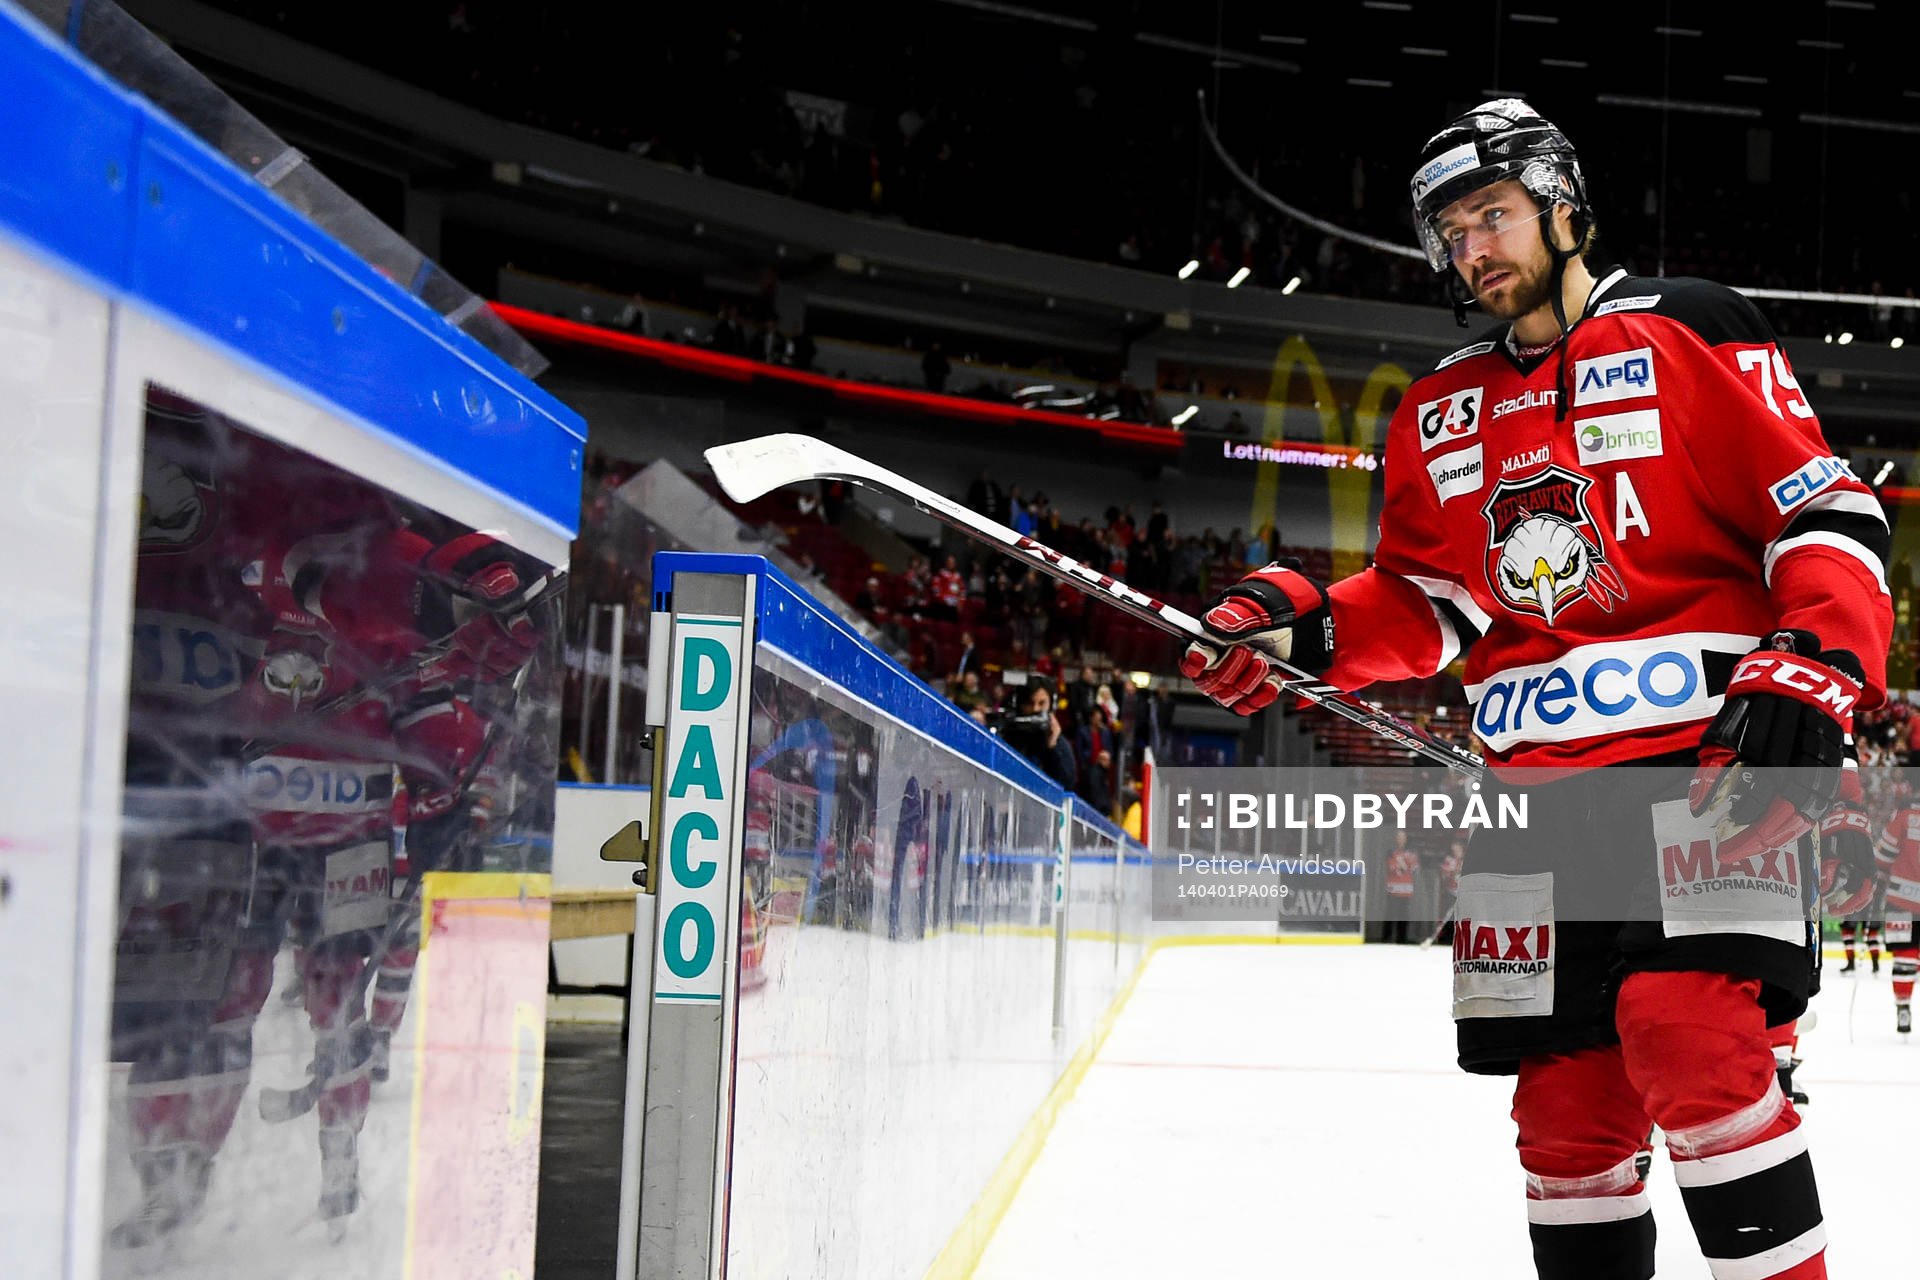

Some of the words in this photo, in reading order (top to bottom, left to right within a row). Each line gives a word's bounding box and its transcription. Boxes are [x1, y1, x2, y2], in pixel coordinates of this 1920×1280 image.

[1424, 161, 1443, 178] OTTO
[1426, 154, 1477, 184] MAGNUSSON
[1735, 348, 1815, 421] 79
[1421, 395, 1476, 439] G4S
[1605, 426, 1658, 449] bring
[1223, 440, 1348, 469] Lottnummer:
[1352, 452, 1378, 472] 46
[1500, 445, 1550, 474] MALMÖ
[1493, 481, 1576, 531] REDHAWKS
[1615, 471, 1651, 541] A
[1476, 650, 1699, 738] areco
[1731, 658, 1855, 717] CCM
[662, 636, 732, 979] DACO
[1666, 886, 1689, 898] ICA
[1693, 878, 1798, 899] STORMARKNAD
[1453, 918, 1550, 961] MAXI
